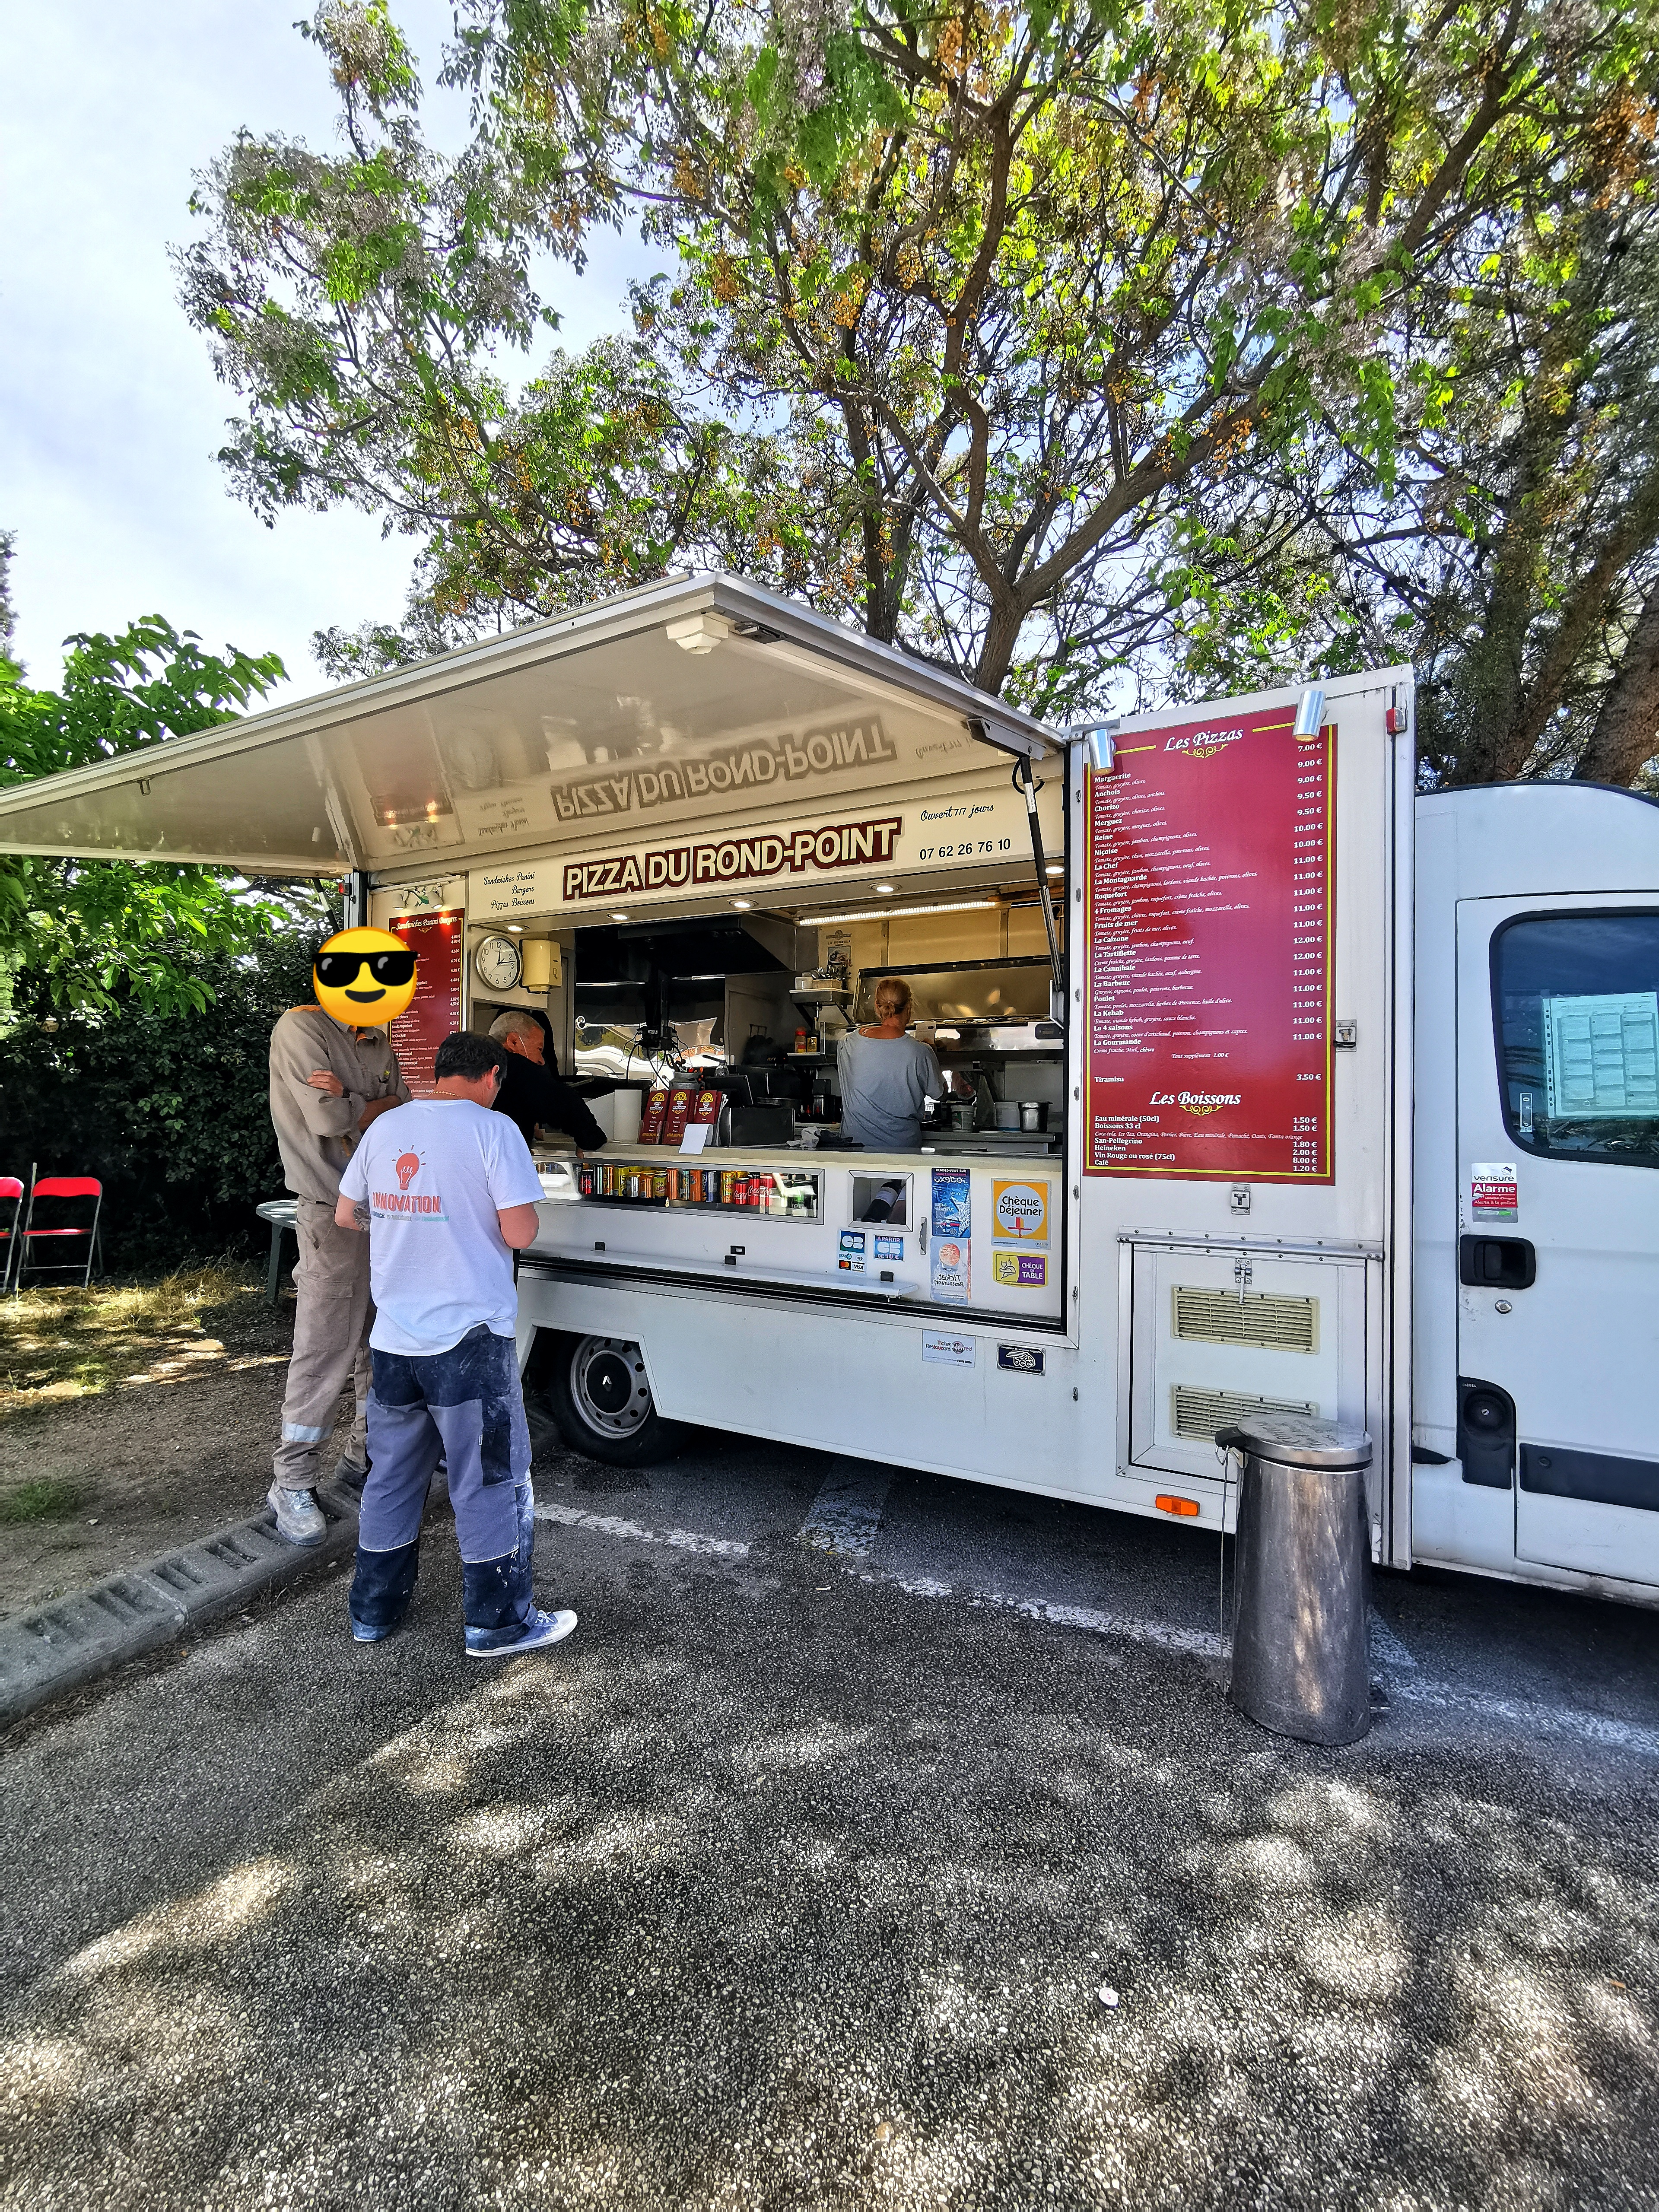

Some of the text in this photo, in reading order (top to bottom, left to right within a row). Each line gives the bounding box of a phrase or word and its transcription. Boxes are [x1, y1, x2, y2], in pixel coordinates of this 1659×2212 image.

[1163, 729, 1244, 752] Les Pizzas
[1298, 744, 1315, 752] 7.00
[1298, 760, 1315, 768] 9.00
[1094, 773, 1131, 783] Marguerite
[1094, 789, 1121, 798] Anchois
[920, 804, 994, 821] Ouvert 7/7 jours
[1297, 807, 1315, 816] 9.50
[1094, 818, 1122, 827] Merguez
[1294, 824, 1316, 833] 10.00
[920, 838, 1011, 860] 07 62 26 76 10
[1294, 840, 1316, 848] 10.00
[1094, 848, 1118, 856] Niçoise
[566, 820, 899, 896] PIZZA DU ROND-POINT
[1294, 856, 1316, 864] 11.00
[483, 871, 535, 885] Sandwiches Panini
[1103, 874, 1147, 884] Montagnarde
[512, 885, 535, 896] Burgers
[1094, 892, 1127, 900] Roquefort
[490, 898, 535, 910] Pizzas Boissons
[1149, 1091, 1241, 1104] Les Boissons
[1474, 1184, 1515, 1192] Alarme
[373, 1192, 441, 1213] INNOVATION
[1002, 1196, 1040, 1208] Chèque
[999, 1205, 1042, 1216] Déjeuner
